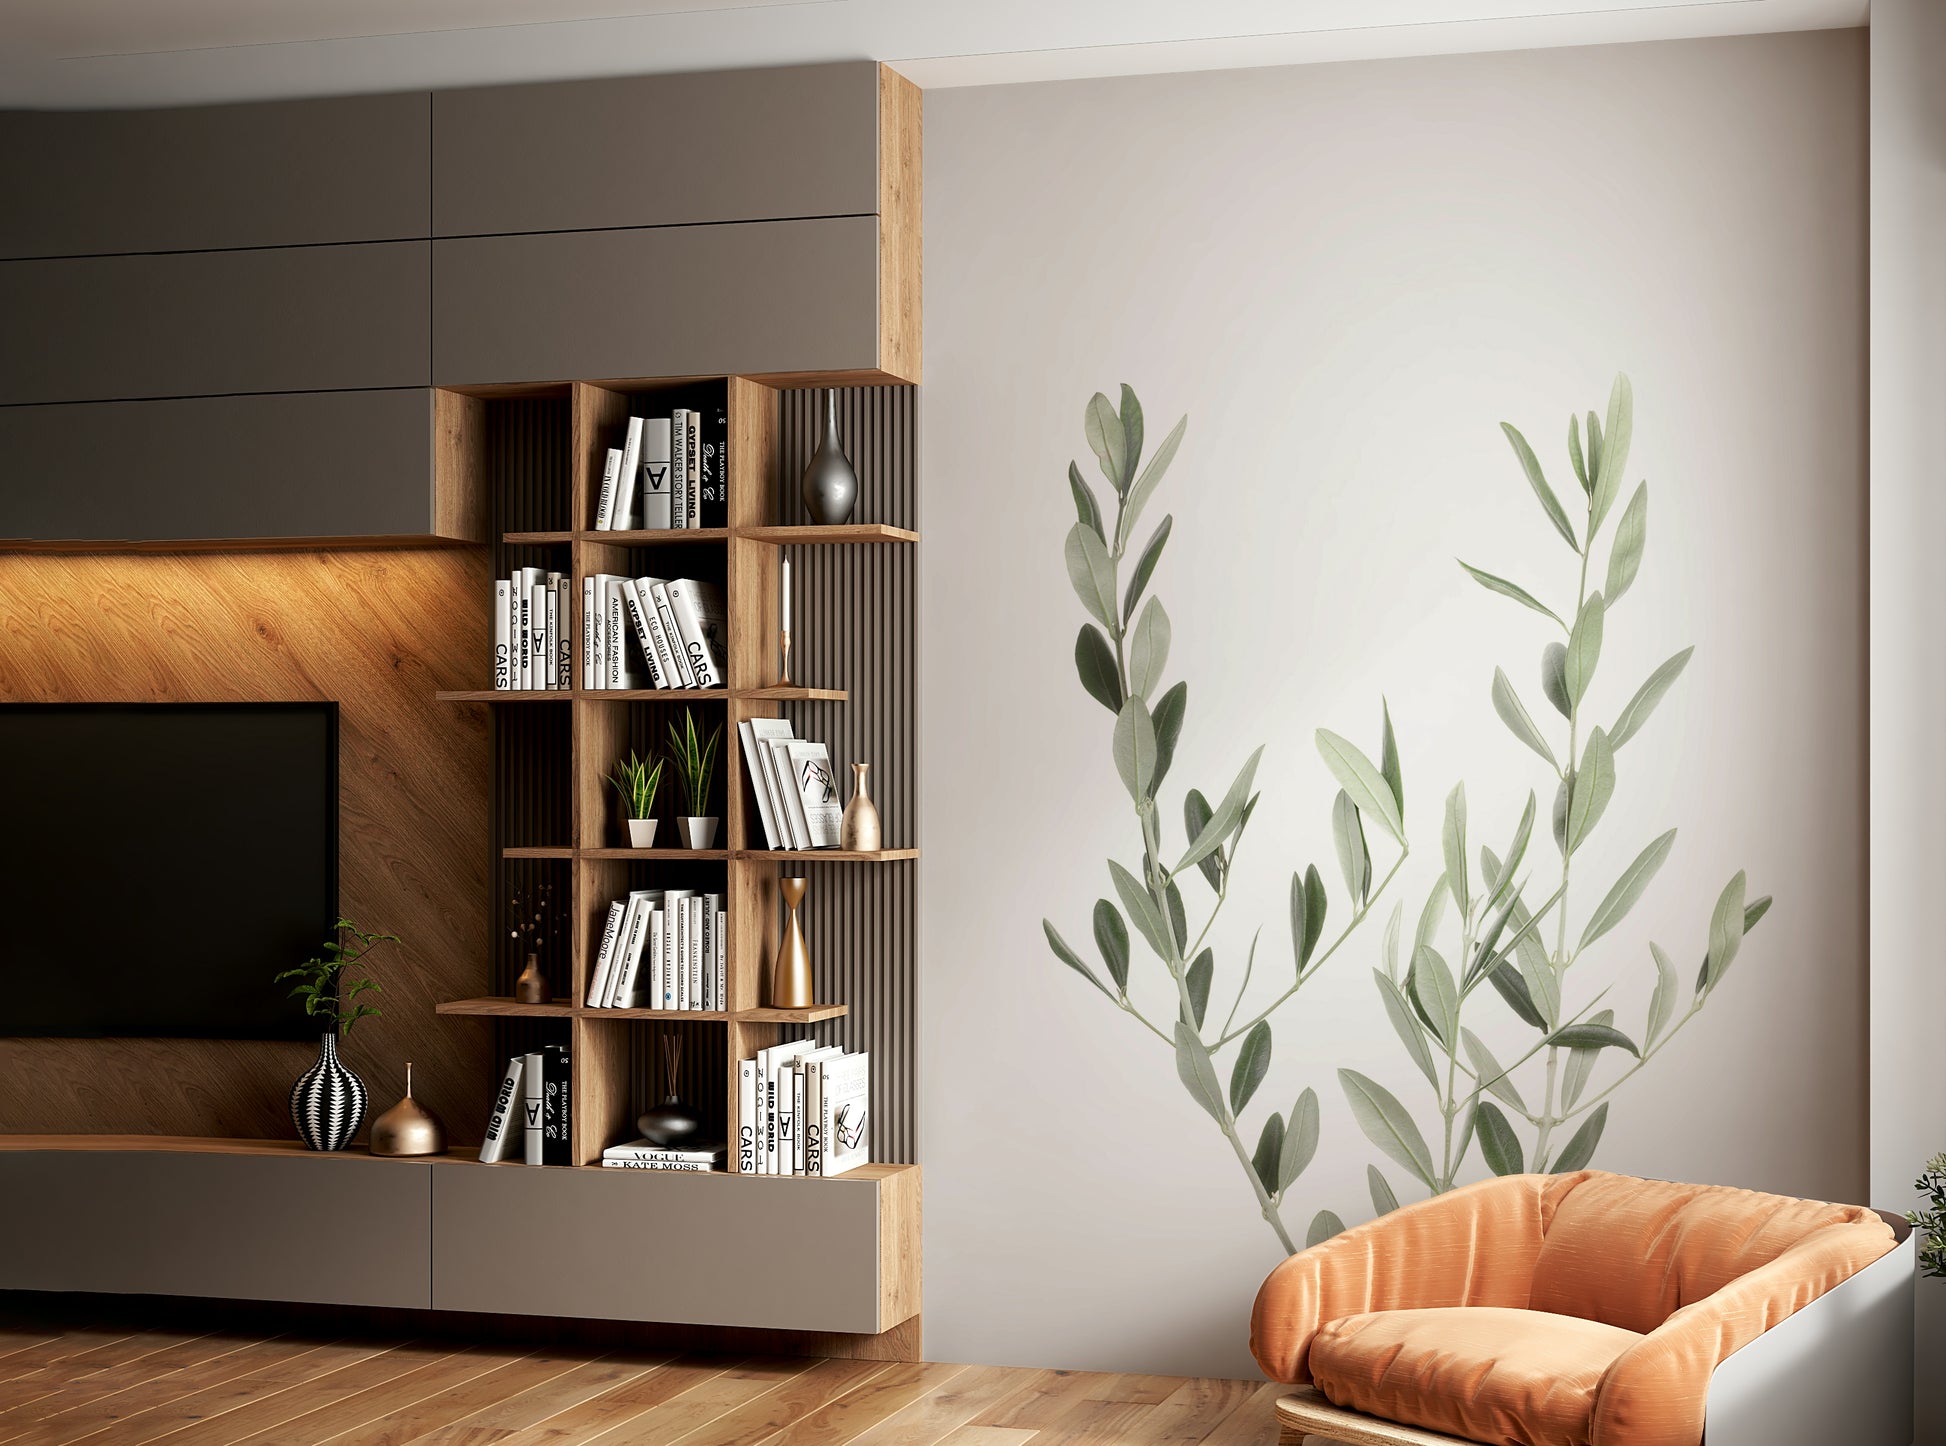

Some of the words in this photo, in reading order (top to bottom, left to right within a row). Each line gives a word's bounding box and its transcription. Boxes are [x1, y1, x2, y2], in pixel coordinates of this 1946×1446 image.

[675, 422, 683, 436] TIM
[688, 425, 696, 472] GYPSET
[675, 437, 683, 472] WALKER
[675, 475, 683, 500] STORY
[688, 480, 696, 519] LIVING
[675, 501, 683, 529] TELLER
[628, 600, 646, 640] GYPSET
[644, 646, 660, 681] LIVING
[649, 616, 659, 631] ECO
[656, 635, 670, 663] HOUSES
[496, 644, 507, 688] CARS
[560, 639, 571, 685] CARS
[688, 641, 712, 686] CARS
[623, 1161, 658, 1169] KATE
[662, 1163, 699, 1171] MOSS
[634, 1152, 684, 1162] VOGUE
[741, 1126, 752, 1171] CARS
[808, 1124, 819, 1171] CARS
